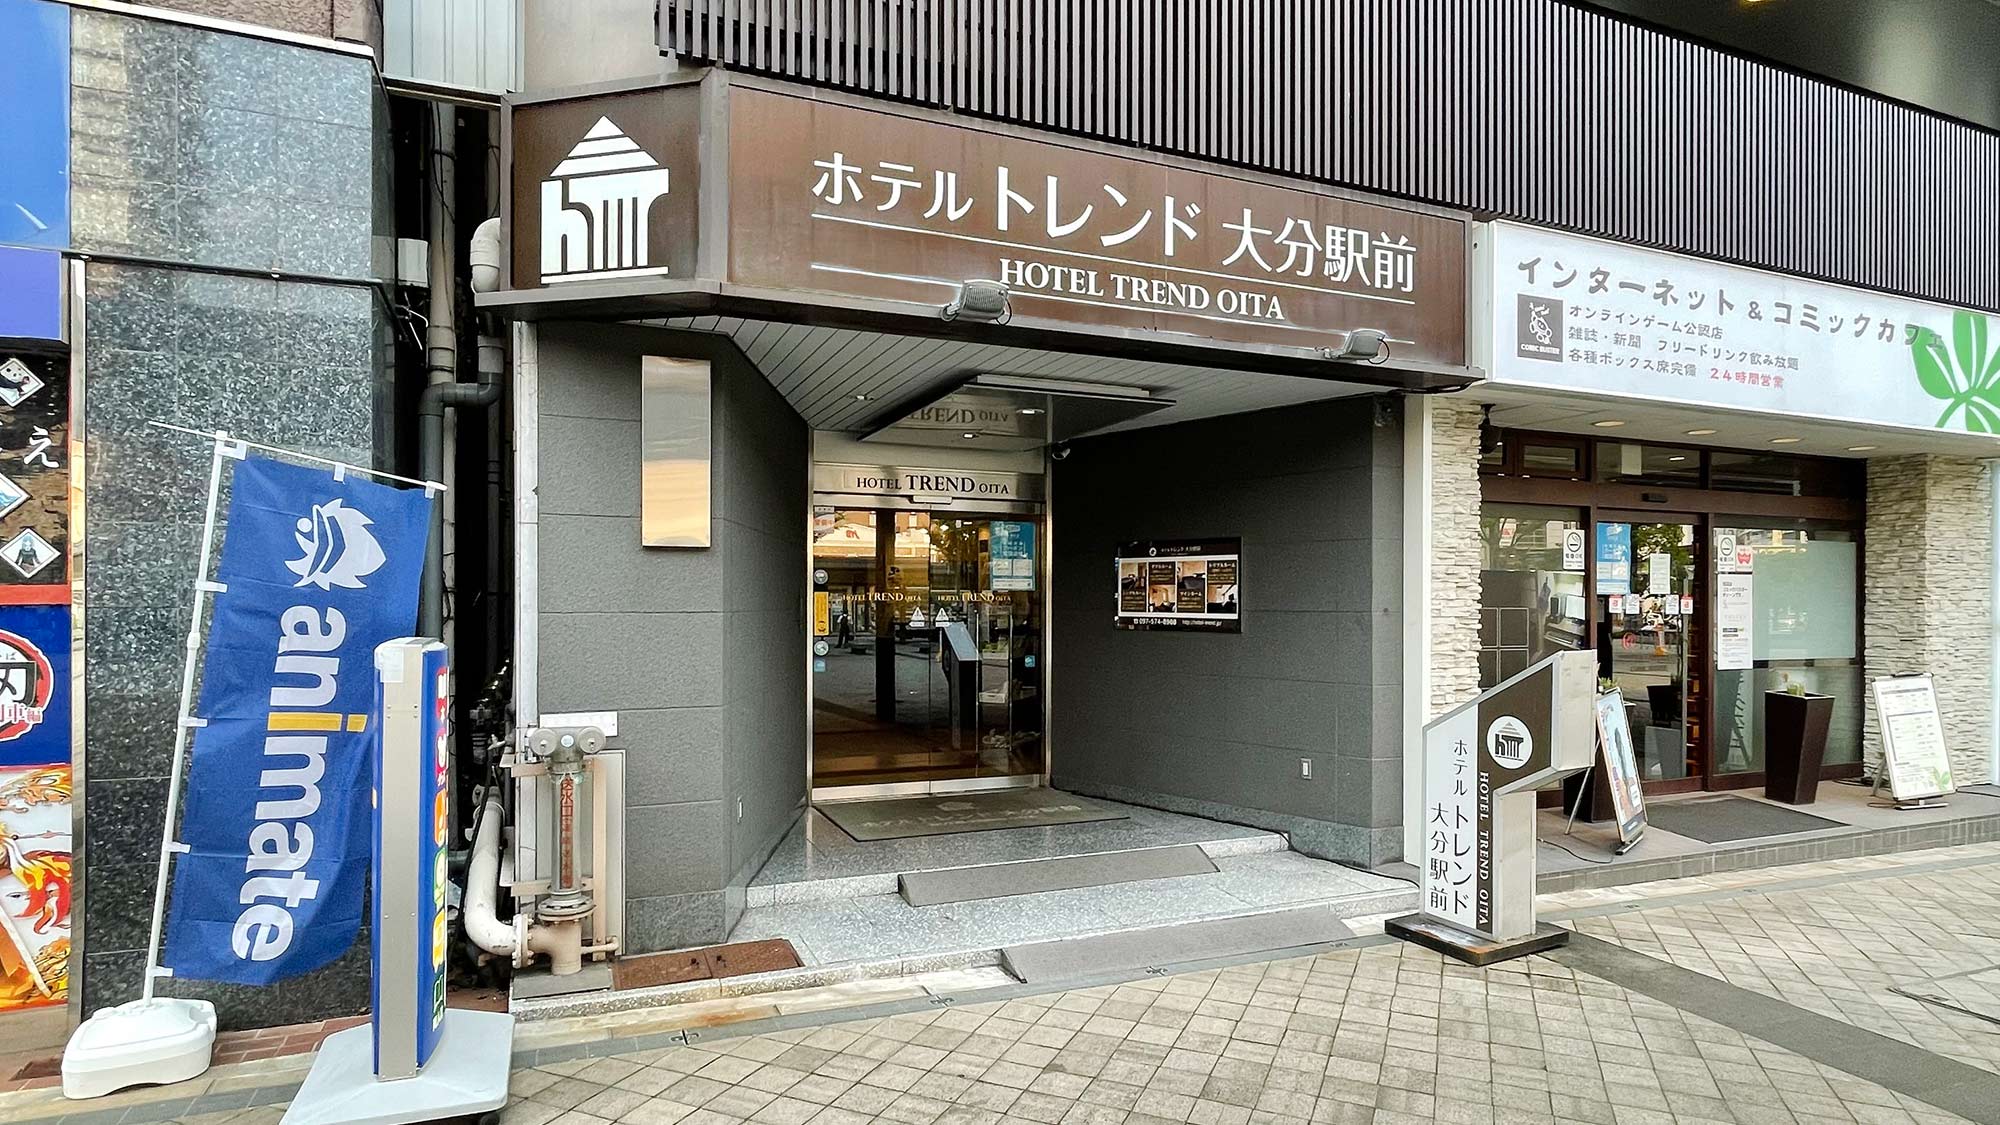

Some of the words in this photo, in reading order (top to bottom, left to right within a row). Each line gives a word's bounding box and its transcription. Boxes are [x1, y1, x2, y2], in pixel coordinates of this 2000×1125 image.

[811, 152, 974, 222] ホテル
[997, 166, 1200, 256] トレンド
[1222, 208, 1417, 293] 大分駅前
[1000, 258, 1104, 296] HOTEL
[1110, 273, 1210, 310] TREND
[1216, 288, 1285, 320] OITA
[1569, 305, 1724, 340] オンラインゲーム公認店
[1568, 348, 1697, 377] 各種ボックス席完備
[1710, 368, 1785, 389] 24時間営業
[1657, 340, 1800, 371] フリードリンク飲み放題
[23, 425, 60, 468] え
[857, 477, 902, 490] HOTEL
[905, 475, 976, 493] TREND
[979, 483, 1009, 495] OITA
[866, 592, 904, 602] TREND
[231, 606, 367, 961] animate
[1479, 771, 1490, 822] HOTEL
[1430, 802, 1449, 912] 大分駅前
[1479, 830, 1490, 881] TREND
[1478, 890, 1490, 926] OITA
